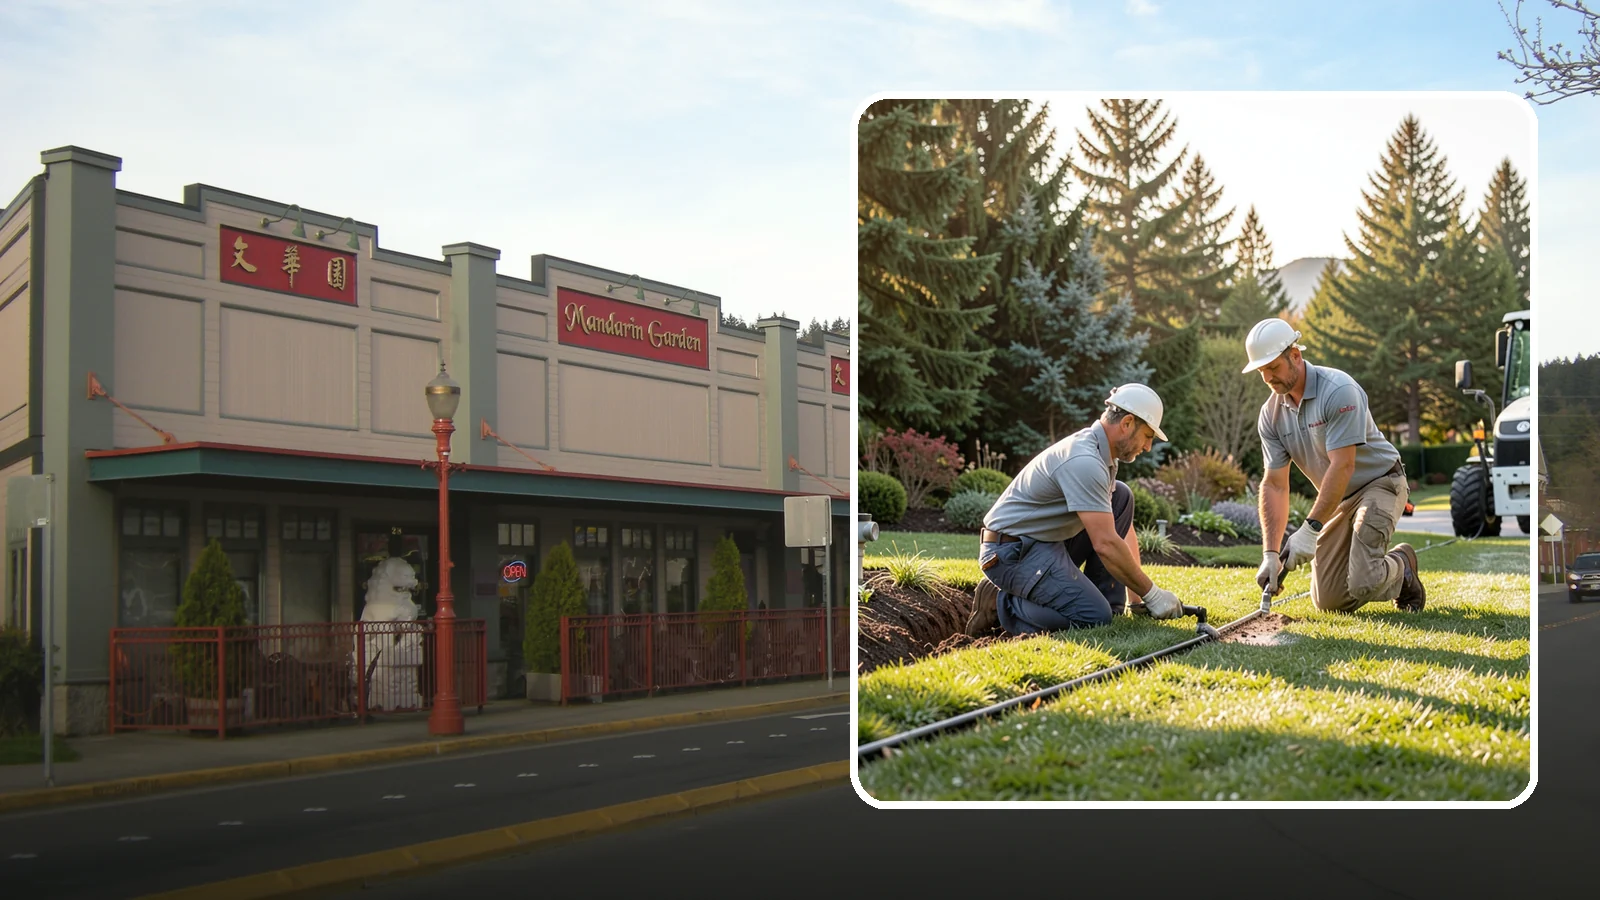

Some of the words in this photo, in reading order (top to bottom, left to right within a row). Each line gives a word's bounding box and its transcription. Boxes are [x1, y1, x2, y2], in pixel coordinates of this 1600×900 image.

[230, 235, 347, 291] 文華園
[564, 302, 644, 342] Mandarin
[648, 320, 702, 352] Garden
[834, 363, 846, 386] 文
[503, 565, 527, 578] OPEN
